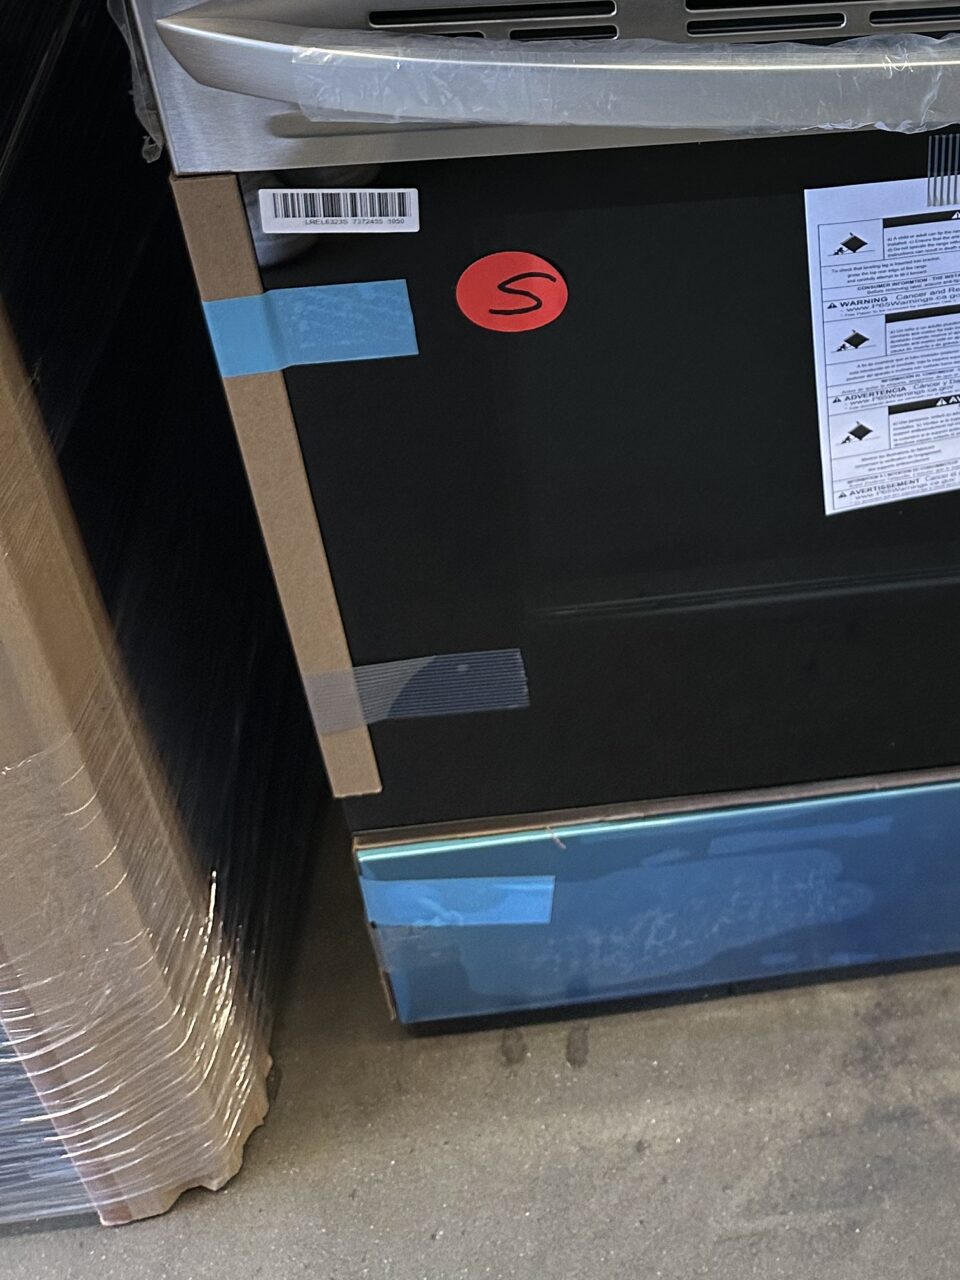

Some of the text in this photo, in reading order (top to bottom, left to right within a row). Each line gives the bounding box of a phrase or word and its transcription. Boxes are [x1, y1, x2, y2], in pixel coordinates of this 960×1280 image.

[489, 272, 557, 316] S
[840, 296, 888, 307] WARNING
[896, 291, 926, 300] Cancer
[844, 386, 906, 401] ADVERTENCIA
